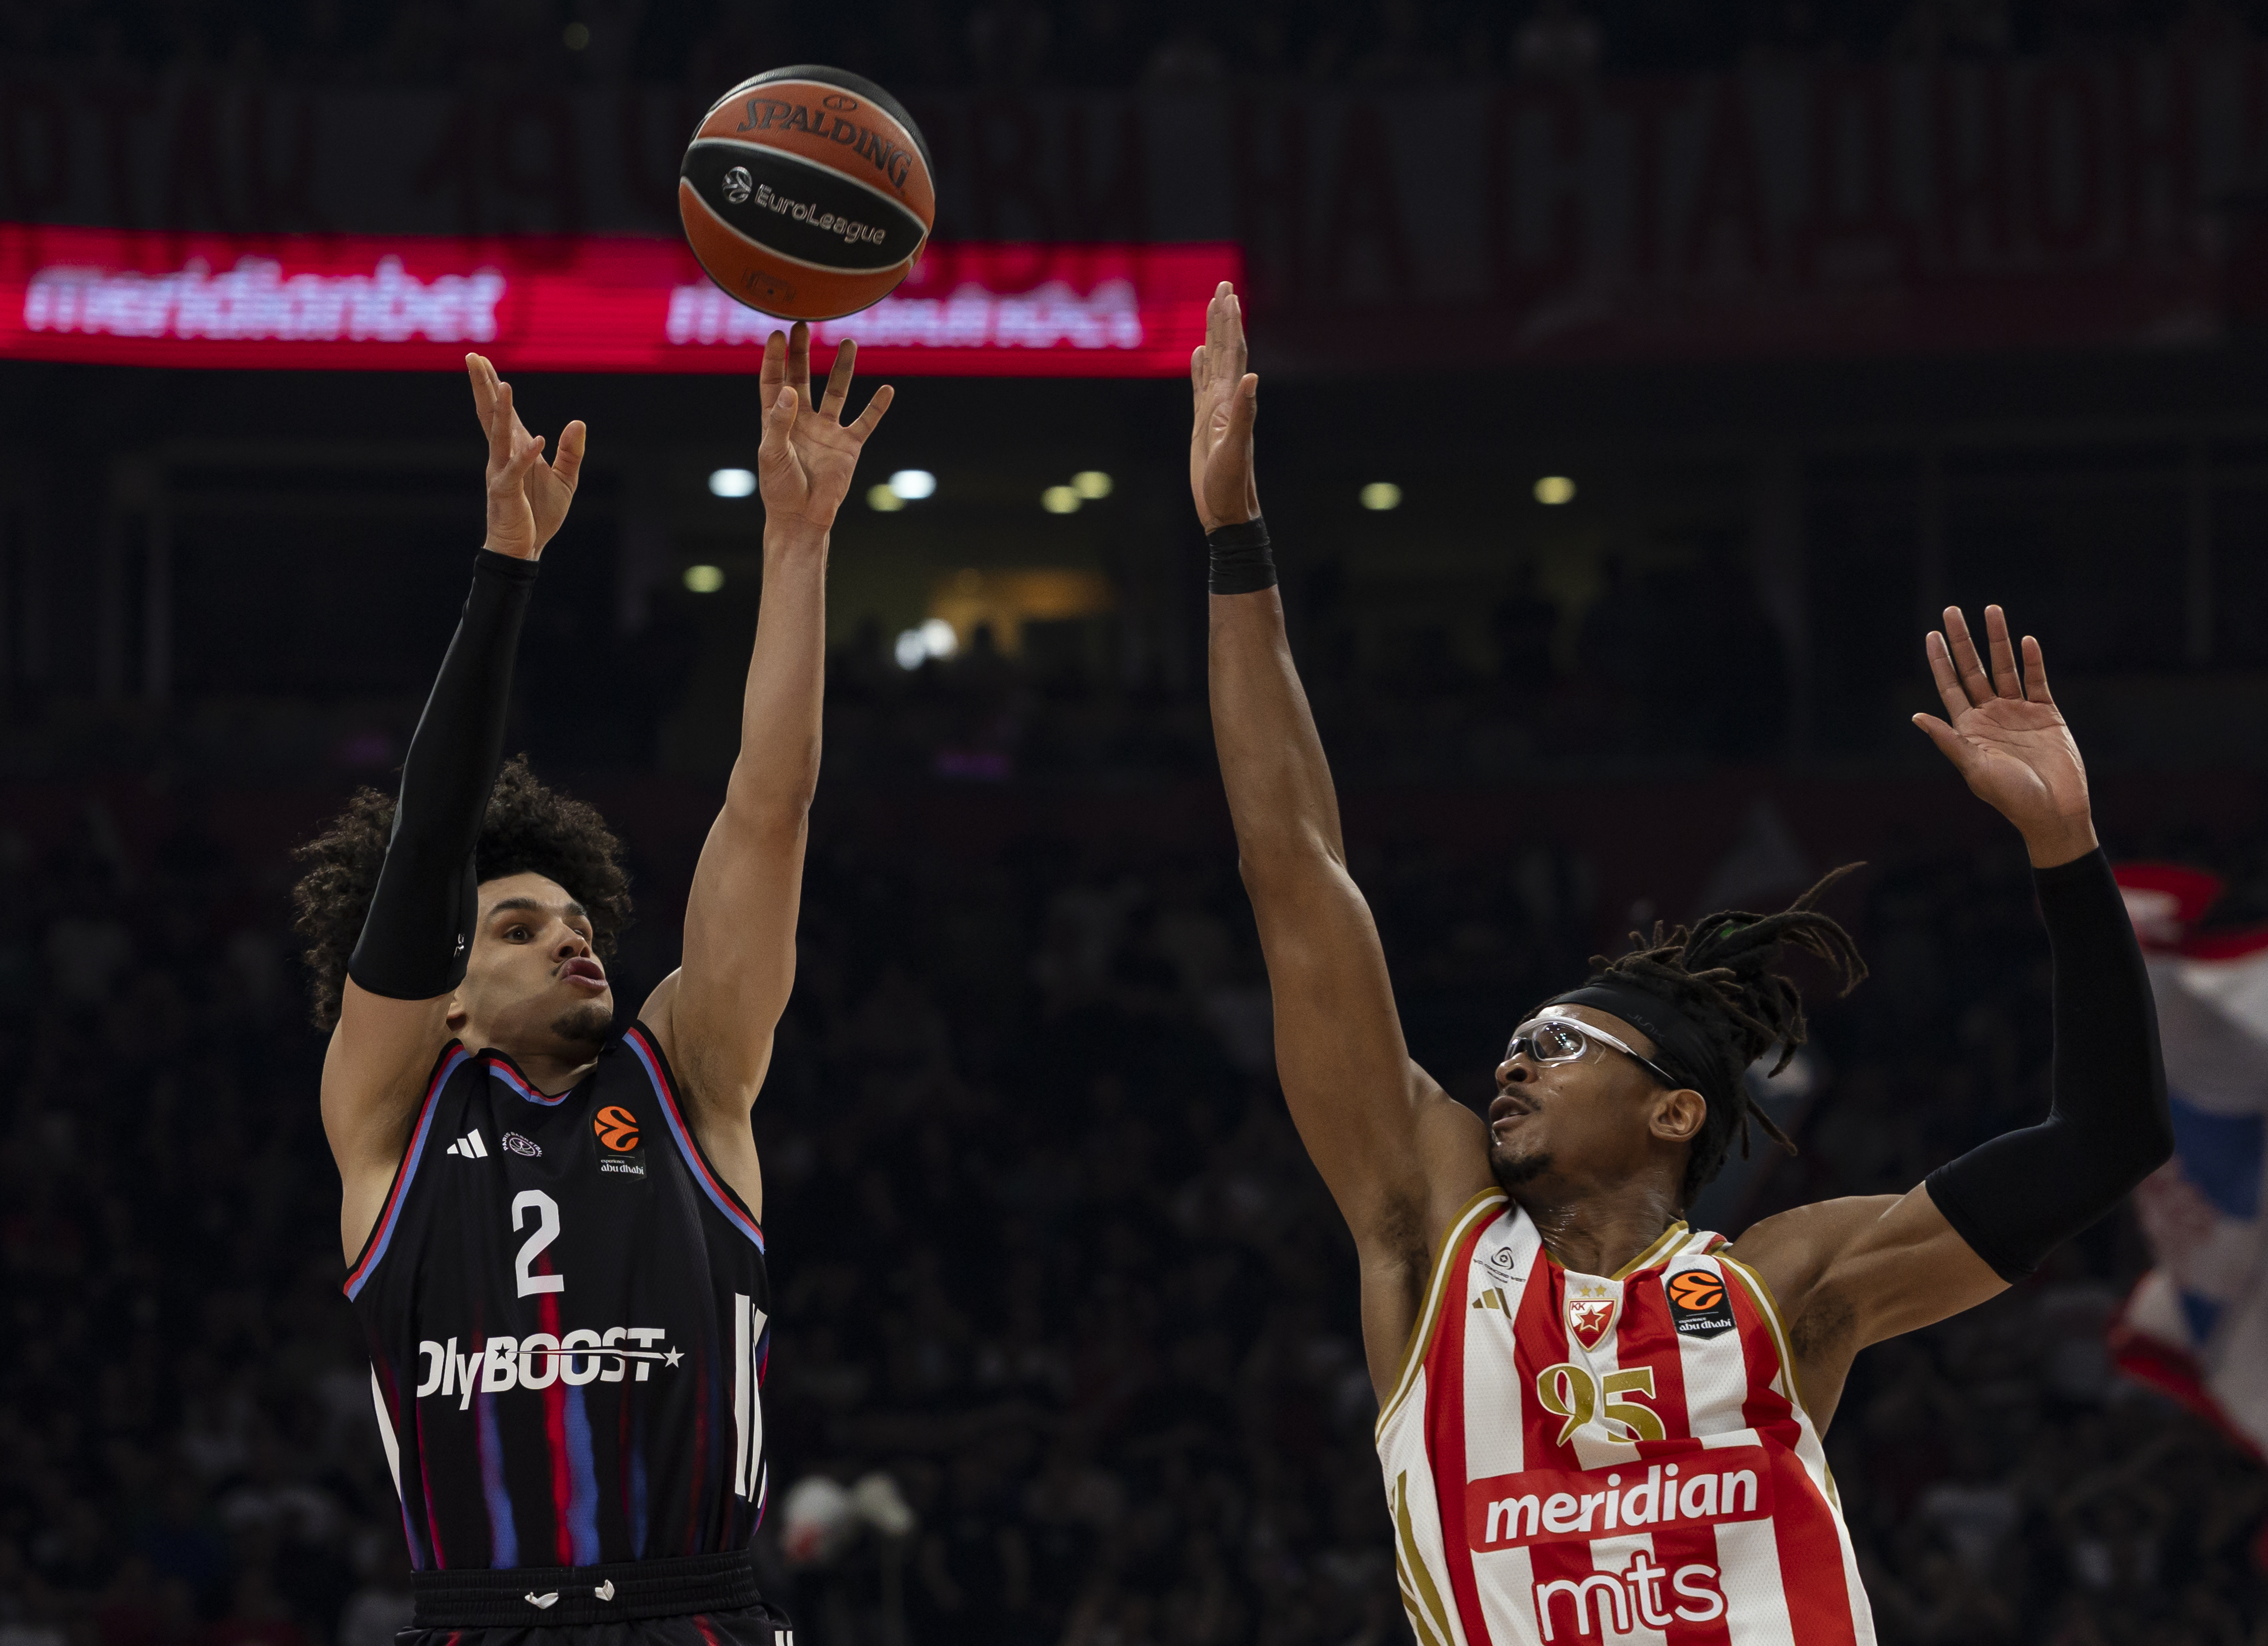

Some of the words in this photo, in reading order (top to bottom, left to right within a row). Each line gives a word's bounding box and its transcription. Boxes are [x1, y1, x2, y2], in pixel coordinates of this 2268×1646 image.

[737, 98, 913, 188] SPALDING
[754, 184, 886, 245] EuroLeague
[502, 1132, 511, 1151] PARIS
[601, 1164, 619, 1172] abu
[619, 1164, 644, 1175] dhabi
[512, 1189, 565, 1299] 2
[1571, 1302, 1586, 1310] KK
[1679, 1323, 1700, 1331] abu
[1701, 1318, 1732, 1329] dhabi
[1537, 1362, 1666, 1448] 95
[1484, 1463, 1758, 1544] meridian
[1535, 1554, 1724, 1642] mts
